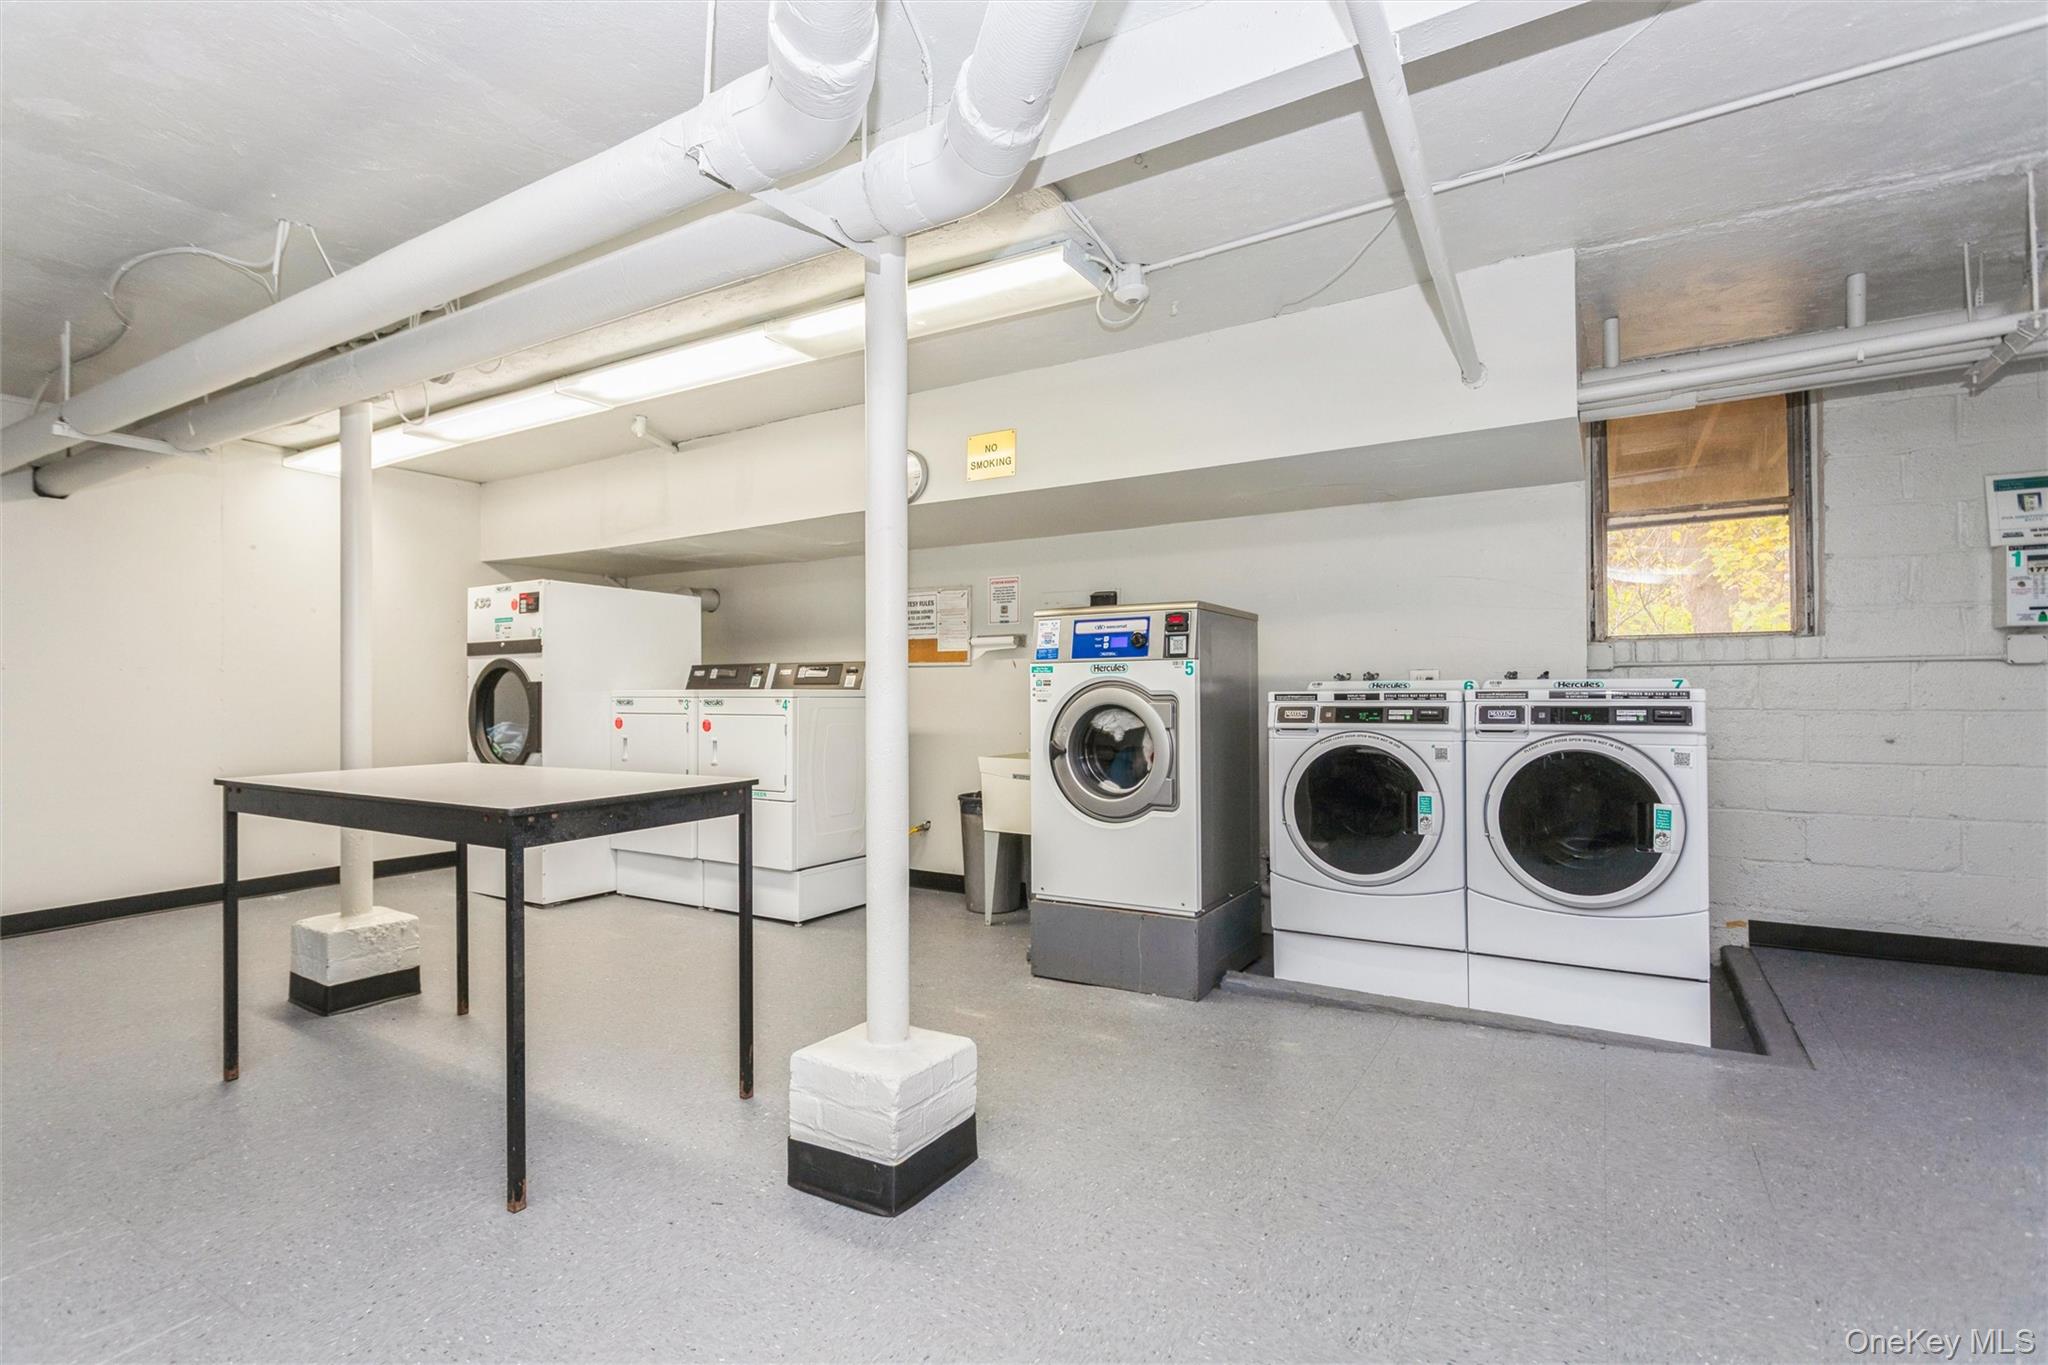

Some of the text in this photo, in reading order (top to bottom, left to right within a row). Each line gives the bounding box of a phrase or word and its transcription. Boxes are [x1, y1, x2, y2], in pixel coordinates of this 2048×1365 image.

[985, 443, 998, 453] NO
[970, 456, 1012, 470] SMOKING
[2012, 551, 2021, 567] 1
[1093, 664, 1126, 673] Hercules
[1185, 661, 1194, 676] 5
[1464, 681, 1474, 690] 6
[1672, 680, 1684, 689] 7
[684, 699, 689, 710] 3
[782, 699, 788, 711] 4
